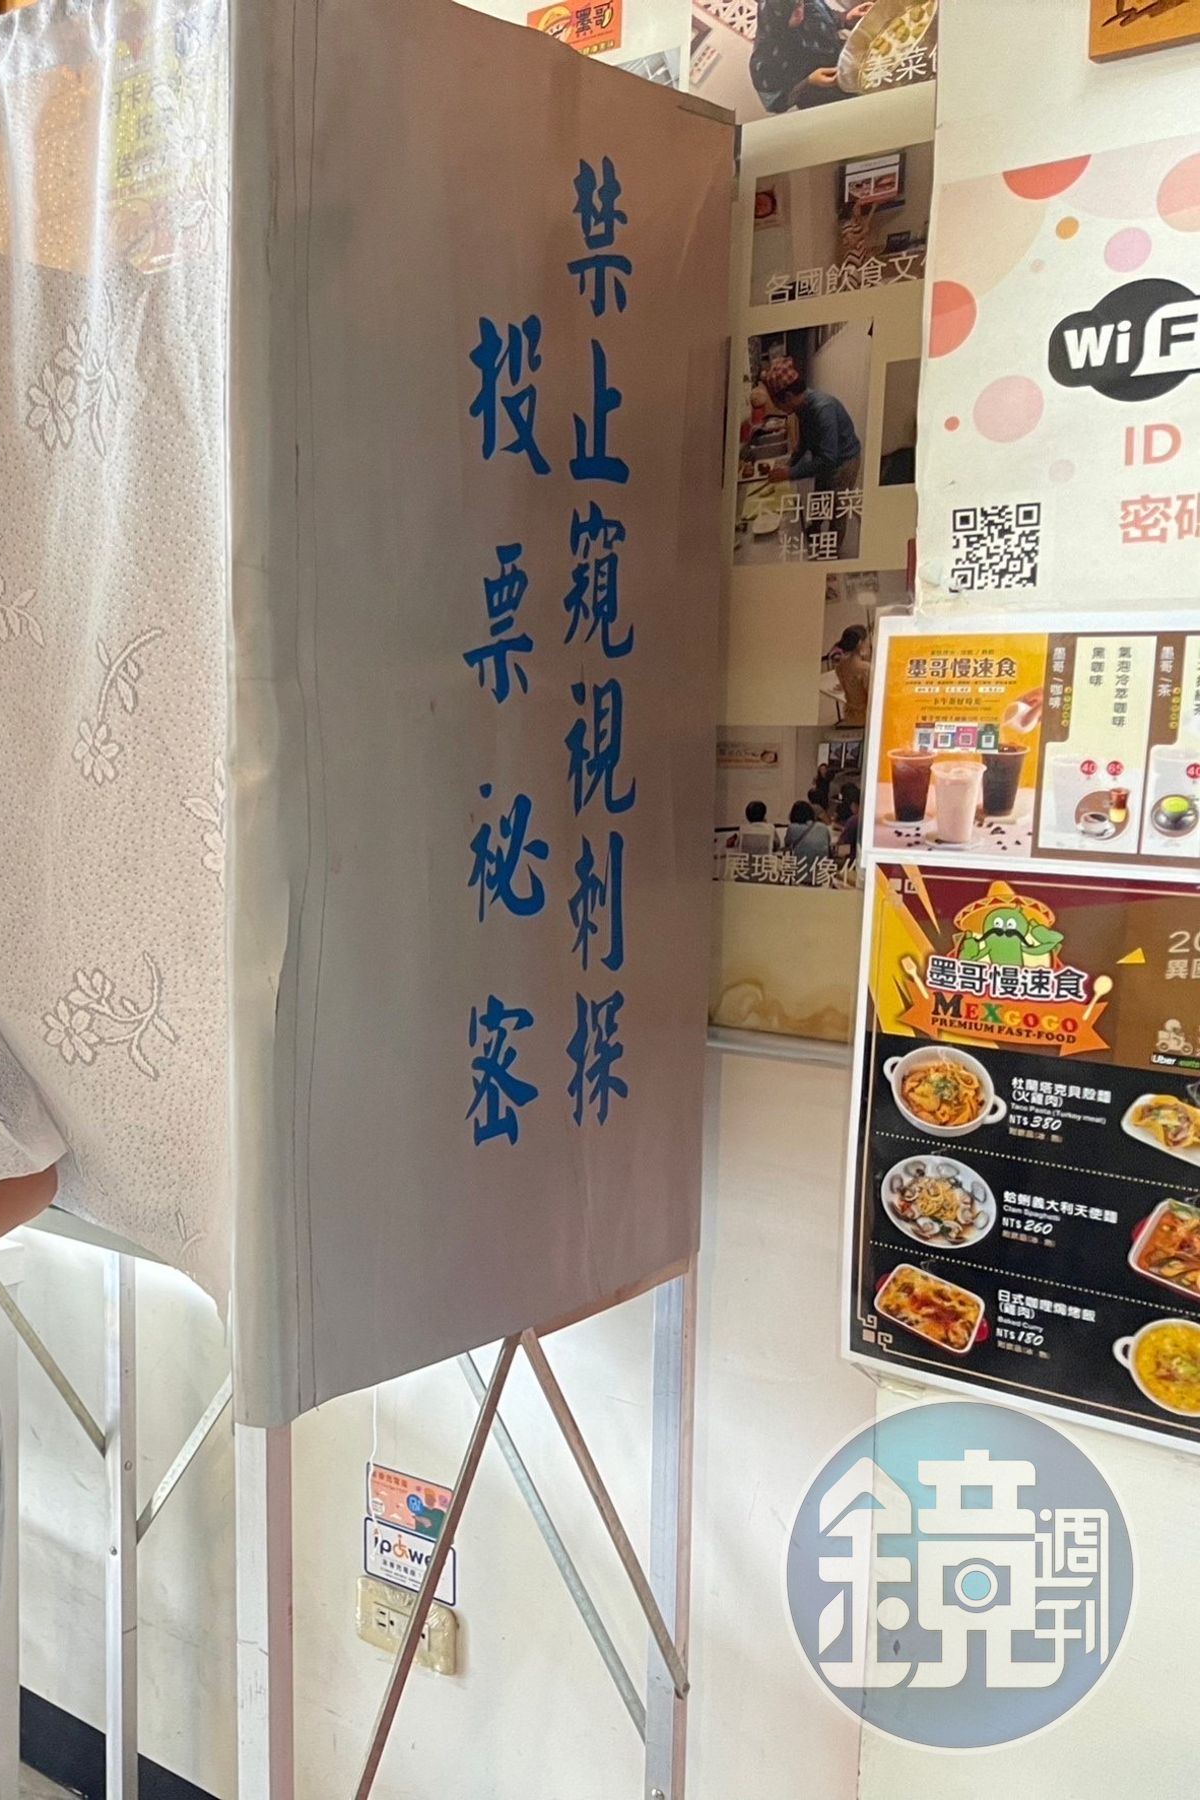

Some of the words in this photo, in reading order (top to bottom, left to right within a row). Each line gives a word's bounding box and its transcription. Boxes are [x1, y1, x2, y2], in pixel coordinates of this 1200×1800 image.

[766, 251, 926, 304] 各國飲食文
[1124, 423, 1182, 466] ID
[780, 531, 839, 562] 料理
[563, 156, 636, 1126] 禁止窺視刺探
[907, 657, 1017, 678] 墨哥慢速食
[1168, 930, 1200, 953] 2
[929, 957, 1085, 999] 墨哥慢速食
[931, 1017, 994, 1033] PREMIUM
[995, 1025, 1077, 1044] FAST-FOOD
[932, 992, 1078, 1033] MEXGOGO
[1152, 1054, 1176, 1065] Uber
